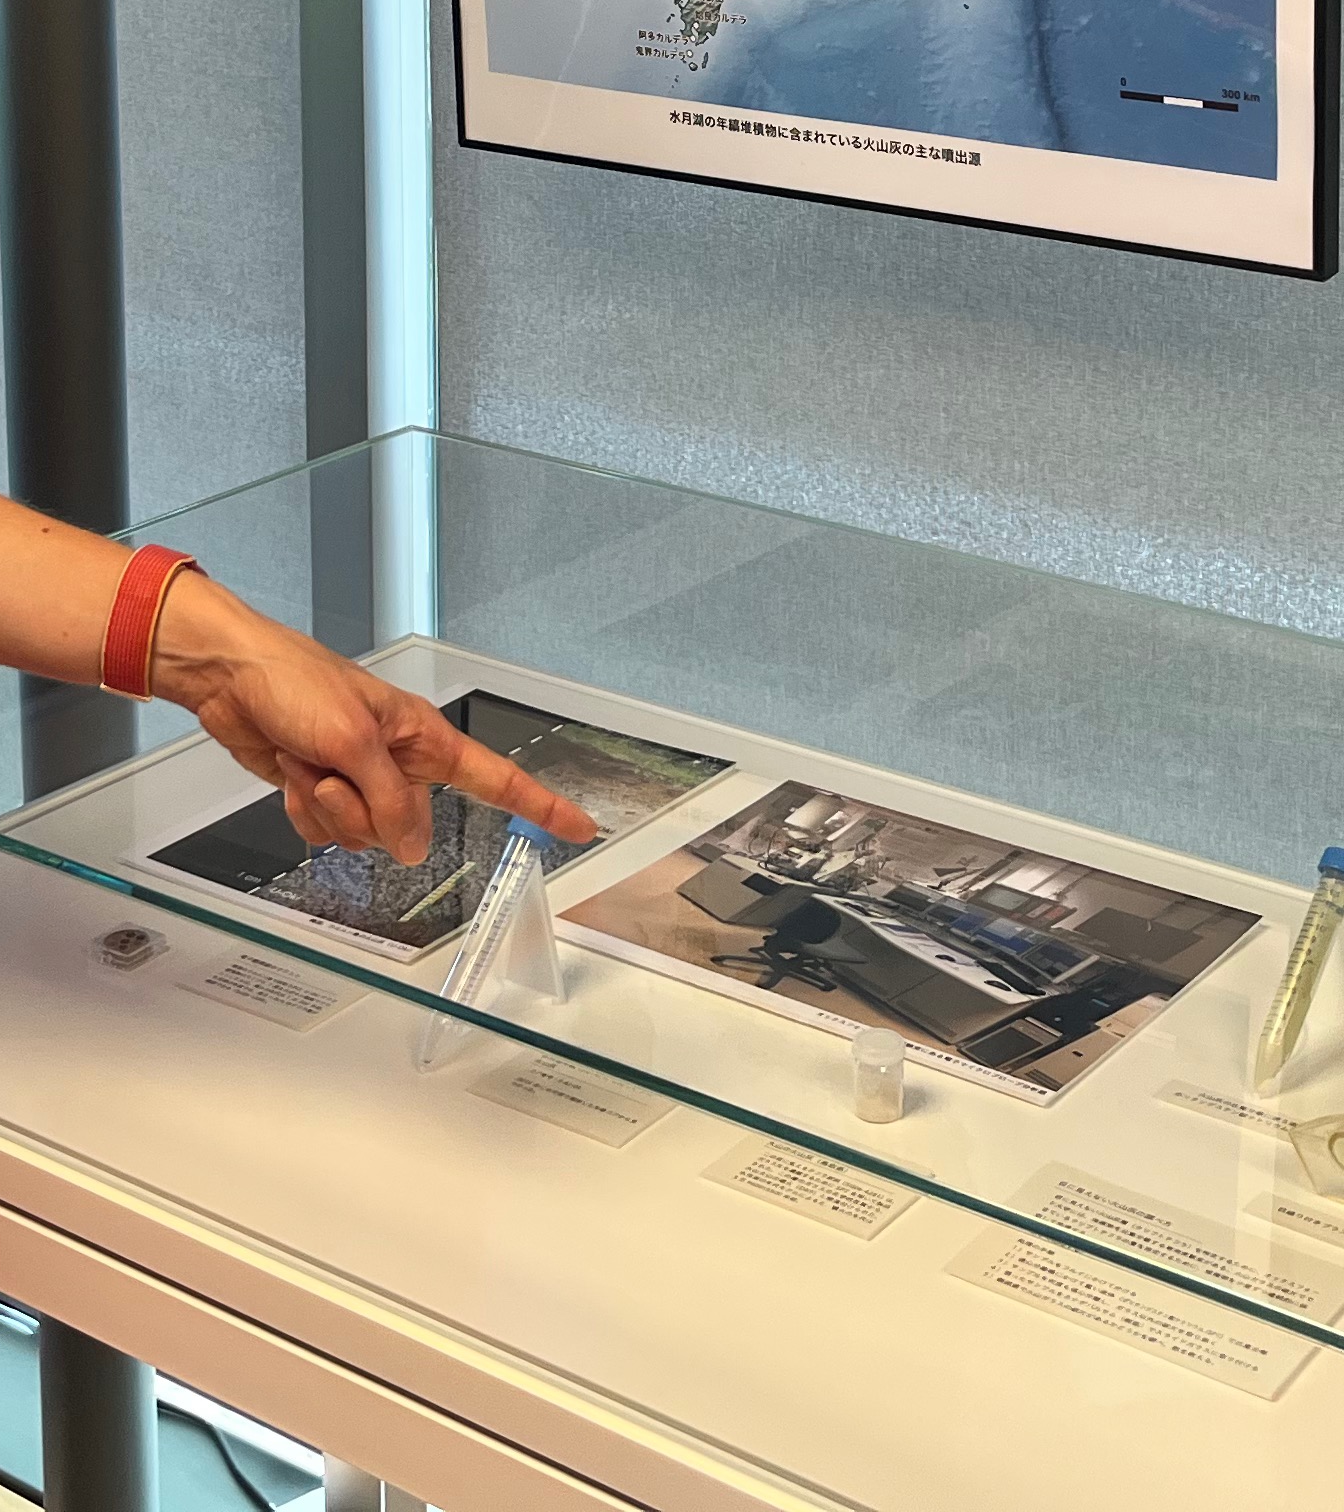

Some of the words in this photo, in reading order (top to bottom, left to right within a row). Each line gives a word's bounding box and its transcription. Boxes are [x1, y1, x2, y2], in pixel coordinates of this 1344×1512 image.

[1221, 89, 1241, 100] 300
[1244, 91, 1261, 103] km
[669, 110, 982, 167] 水月湖の年縞堆積物に含まれている火山灰の主な噴出源
